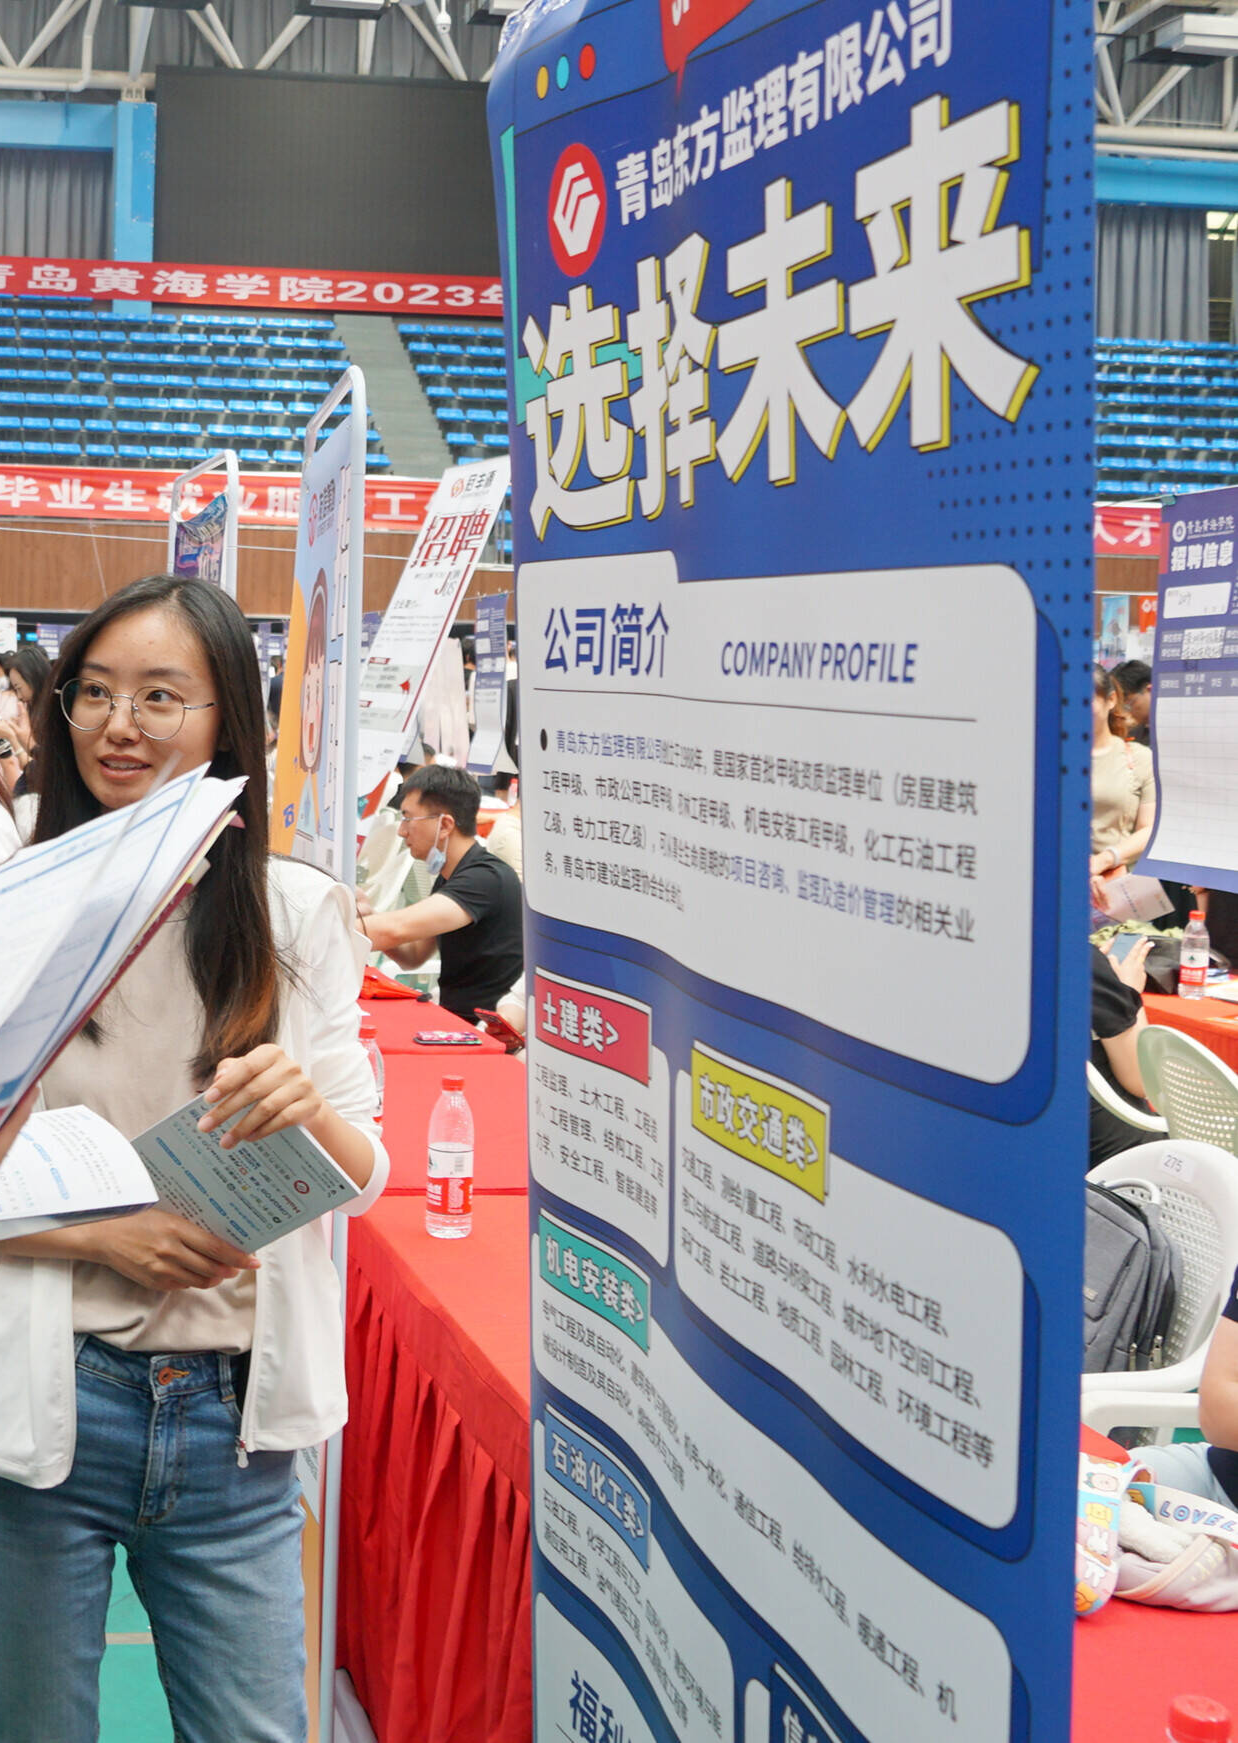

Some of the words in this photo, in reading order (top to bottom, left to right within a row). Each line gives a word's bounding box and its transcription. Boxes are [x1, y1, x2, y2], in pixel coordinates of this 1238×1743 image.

[615, 0, 952, 225] 青岛东方监理有限公司
[525, 94, 1040, 541] 选择未来
[410, 508, 491, 569] 招聘
[1170, 540, 1235, 572] 招聘信息
[544, 602, 670, 678] 公司简介
[721, 640, 817, 681] COMPANY
[819, 642, 918, 684] PROFILE
[542, 991, 604, 1052] 土建类
[699, 1073, 807, 1171] 市政交通类
[1163, 1154, 1183, 1173] 275
[546, 1233, 637, 1326] 机电安装类
[551, 1431, 638, 1539] 石油化工类
